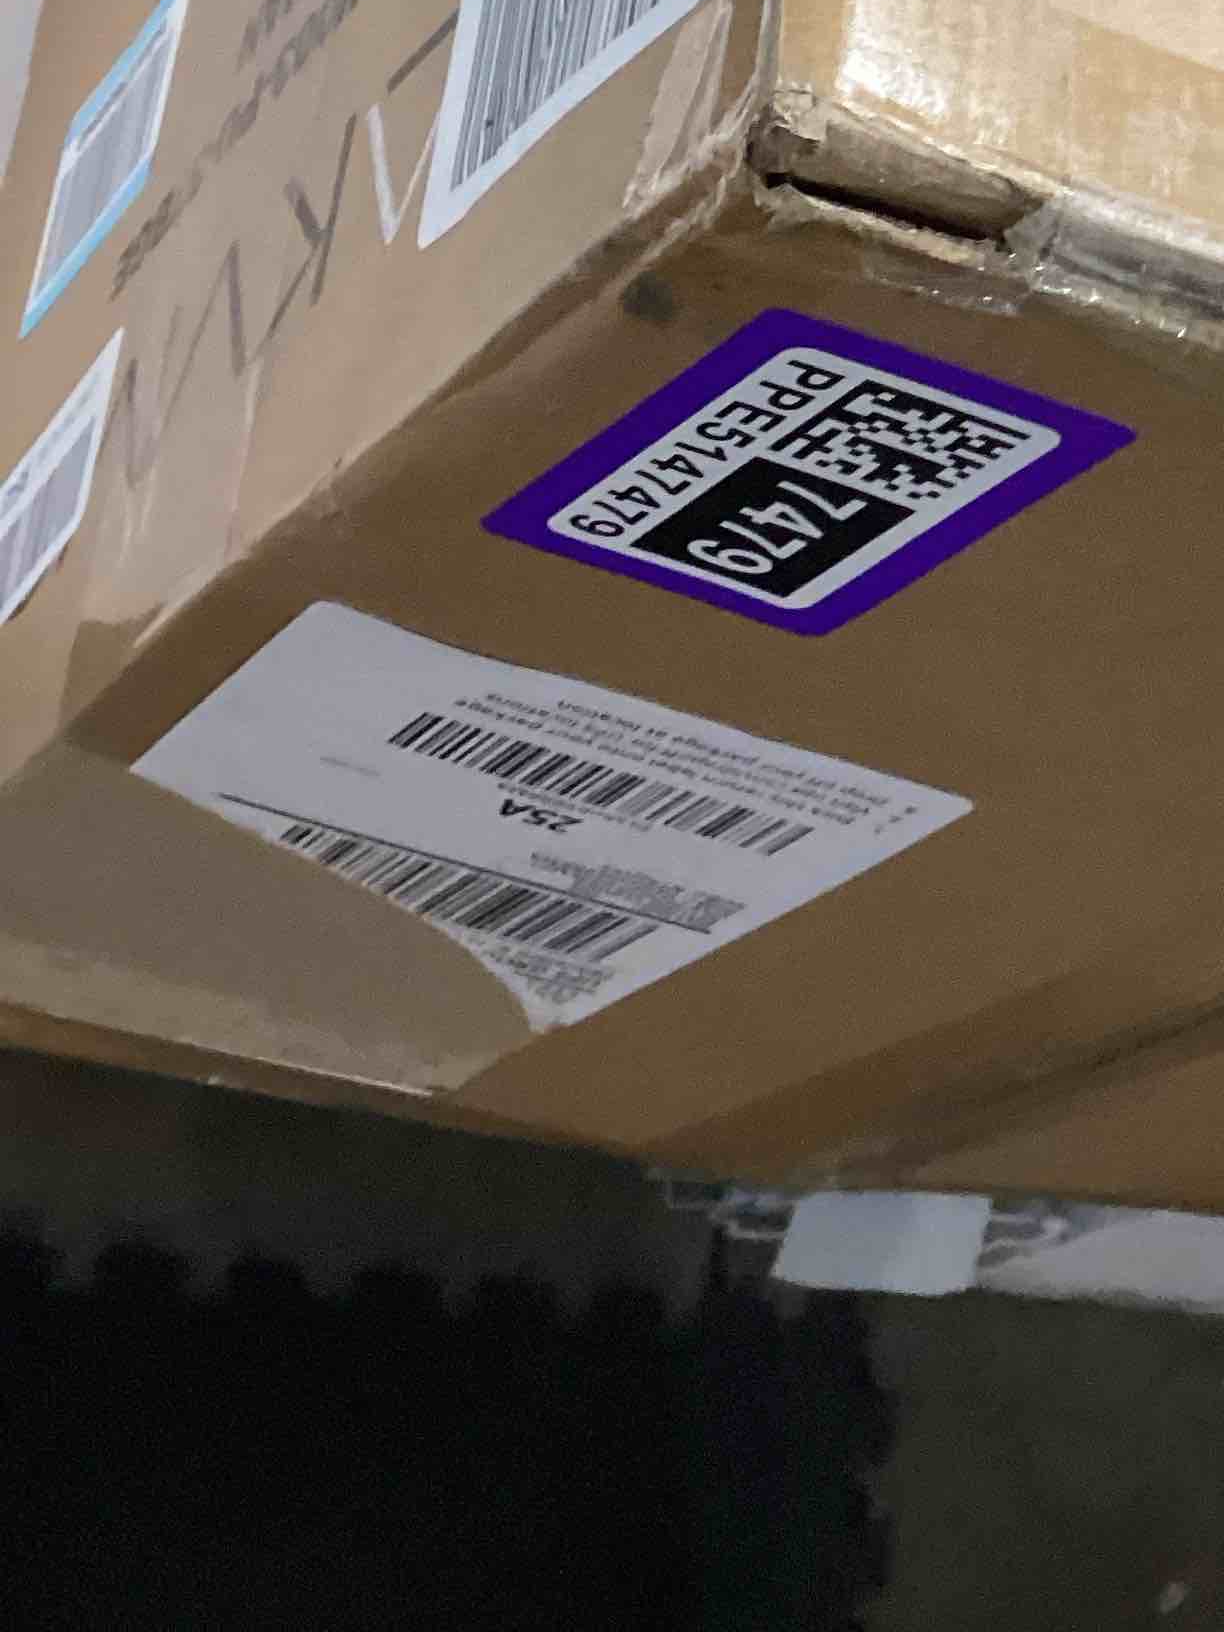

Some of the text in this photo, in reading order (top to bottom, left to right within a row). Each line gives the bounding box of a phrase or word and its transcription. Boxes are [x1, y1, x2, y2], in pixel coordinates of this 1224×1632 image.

[567, 358, 848, 540] PPE5147479
[684, 478, 868, 576] 7479
[487, 797, 584, 834] 25A
